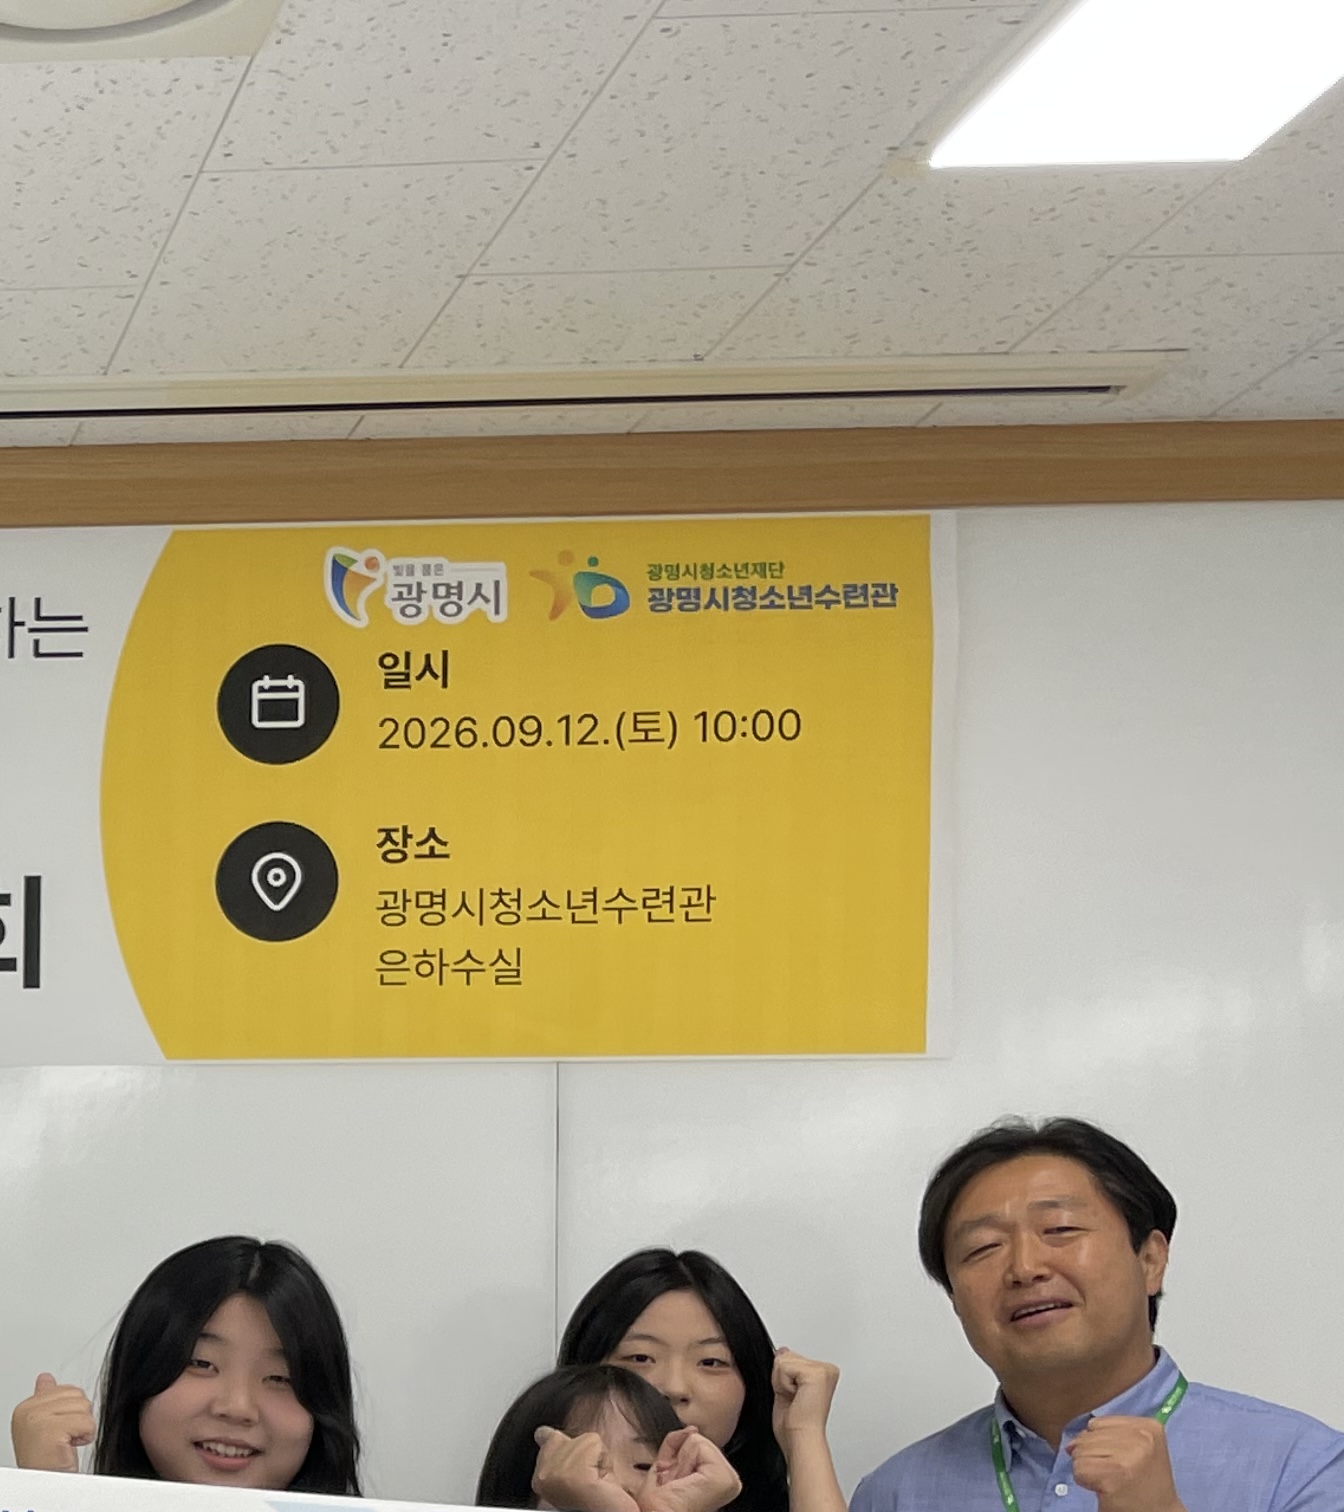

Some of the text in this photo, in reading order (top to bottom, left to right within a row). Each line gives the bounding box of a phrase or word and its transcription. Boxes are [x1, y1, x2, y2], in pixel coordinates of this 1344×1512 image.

[647, 561, 785, 581] 광명시청소년재단
[391, 580, 500, 618] 광명시
[648, 582, 899, 613] 광명시청소년수련관
[378, 650, 450, 689] 일시
[377, 708, 802, 752] 2026.09.12.(토) 10:00
[376, 824, 451, 863] 장소
[376, 884, 717, 928] 광명시청소년수련관
[375, 946, 523, 988] 은하수실
